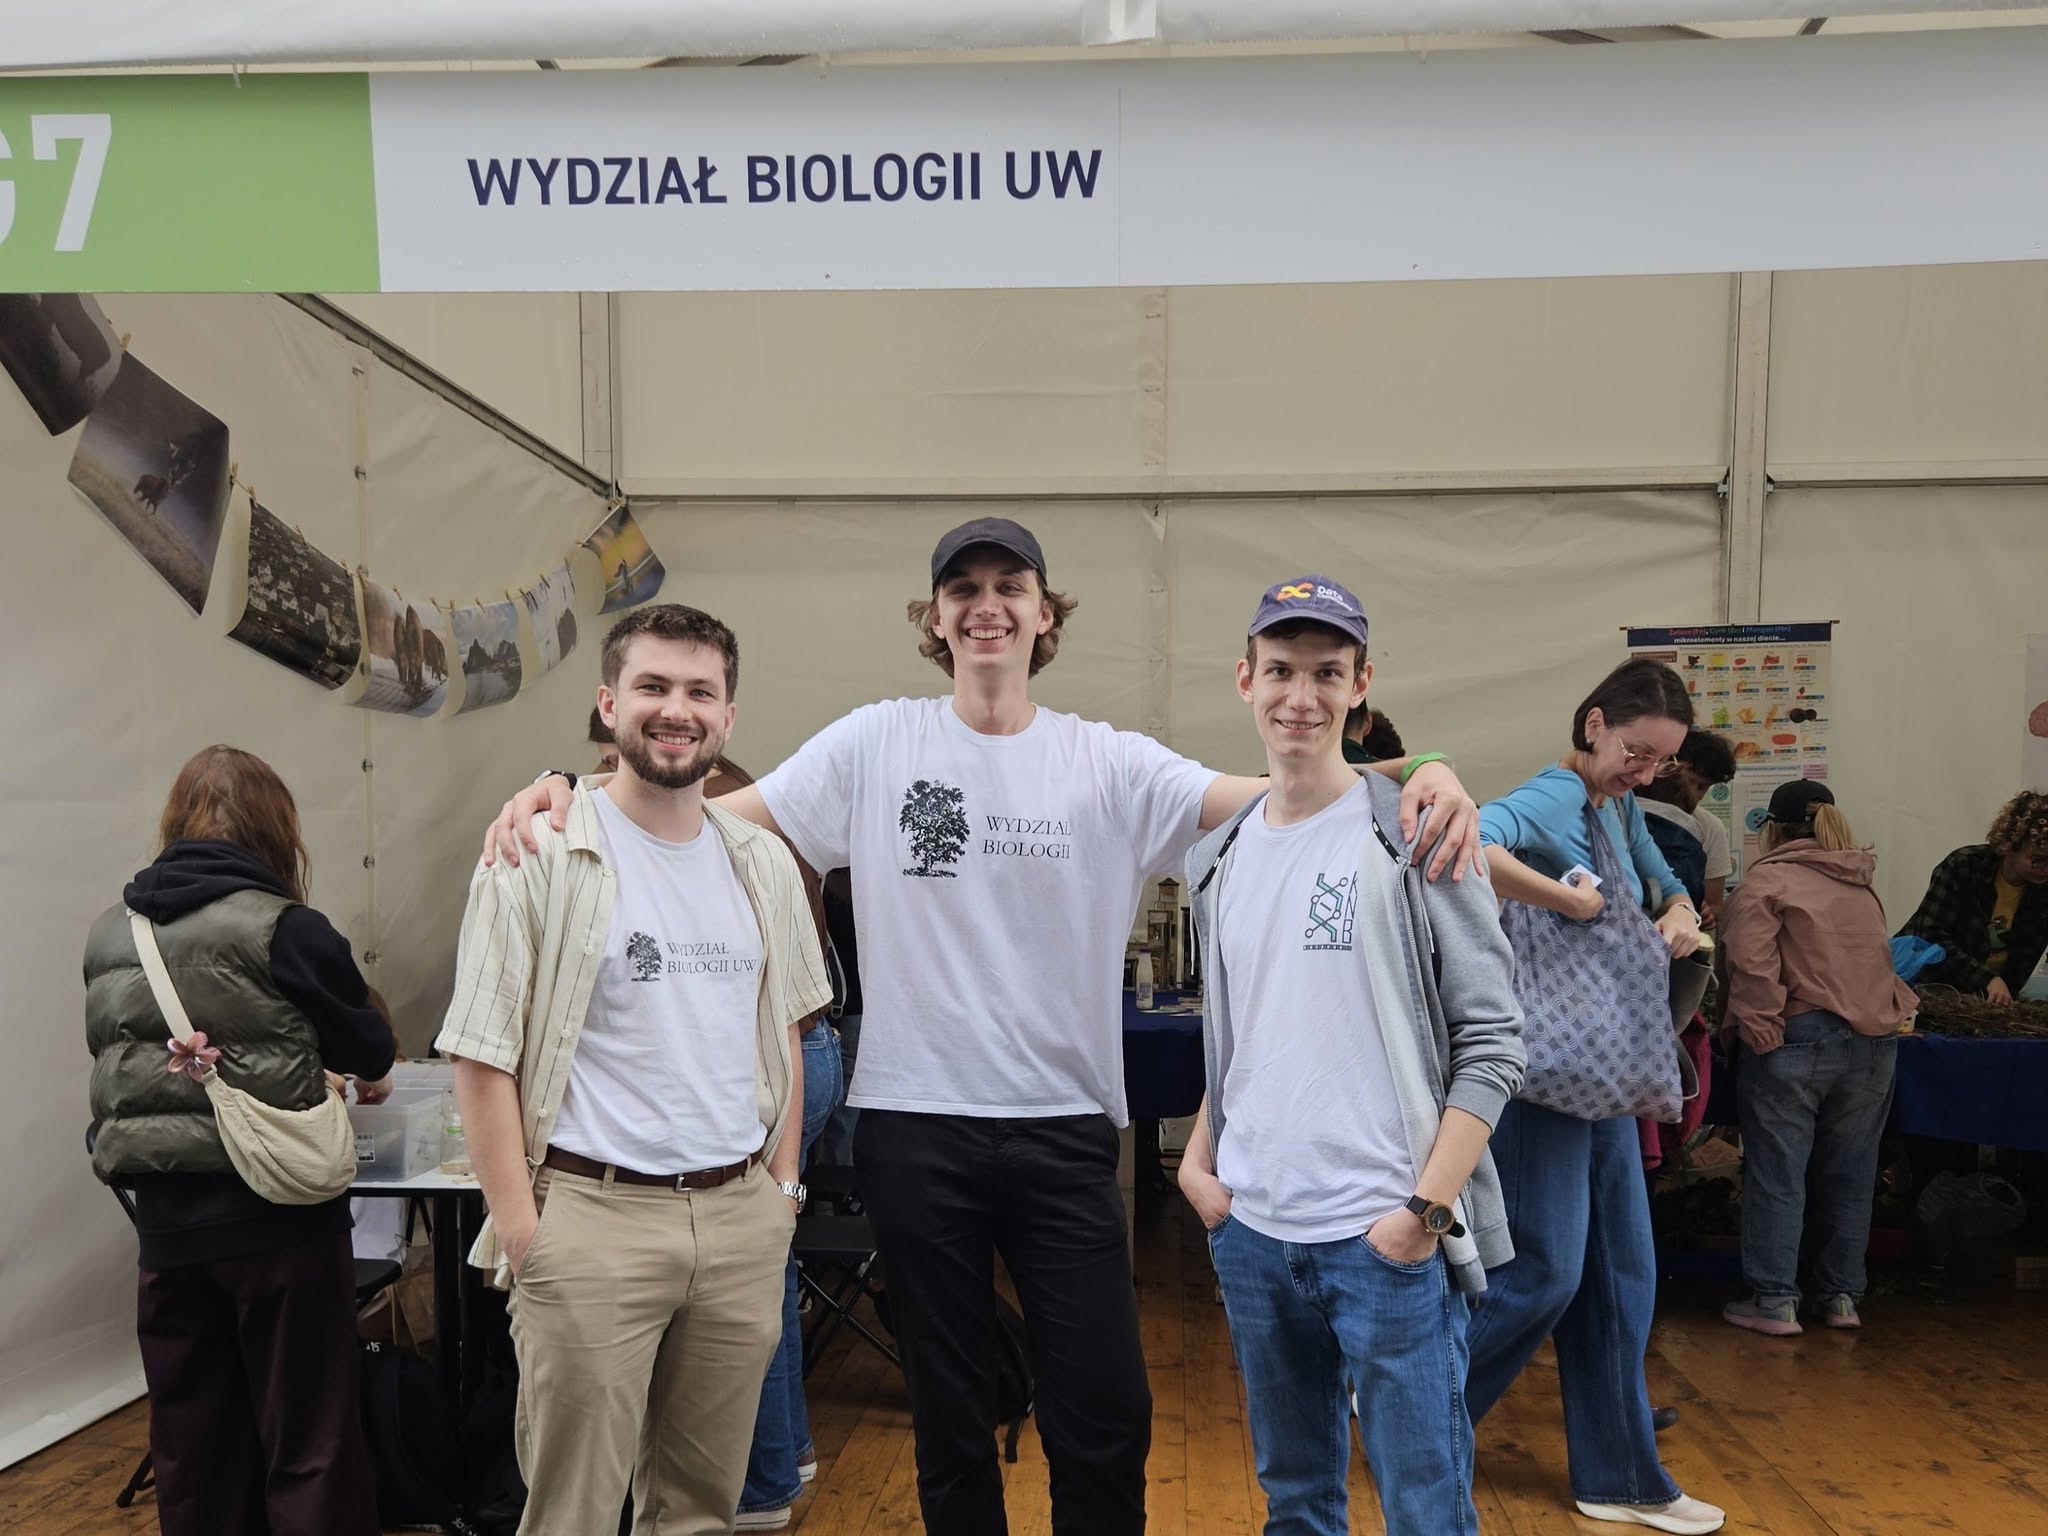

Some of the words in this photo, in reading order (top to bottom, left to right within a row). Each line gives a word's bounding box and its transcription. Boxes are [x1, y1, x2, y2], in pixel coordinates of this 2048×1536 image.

[0, 113, 112, 252] 7
[466, 155, 728, 206] WYDZIAŁ
[746, 152, 982, 204] BIOLOGII
[1004, 149, 1102, 200] UW
[1317, 585, 1343, 601] Data
[983, 839, 1071, 859] BIOLOGII
[667, 942, 729, 956] WYDZIAŁ
[667, 959, 728, 974] BIOLOGII
[733, 958, 757, 972] UW
